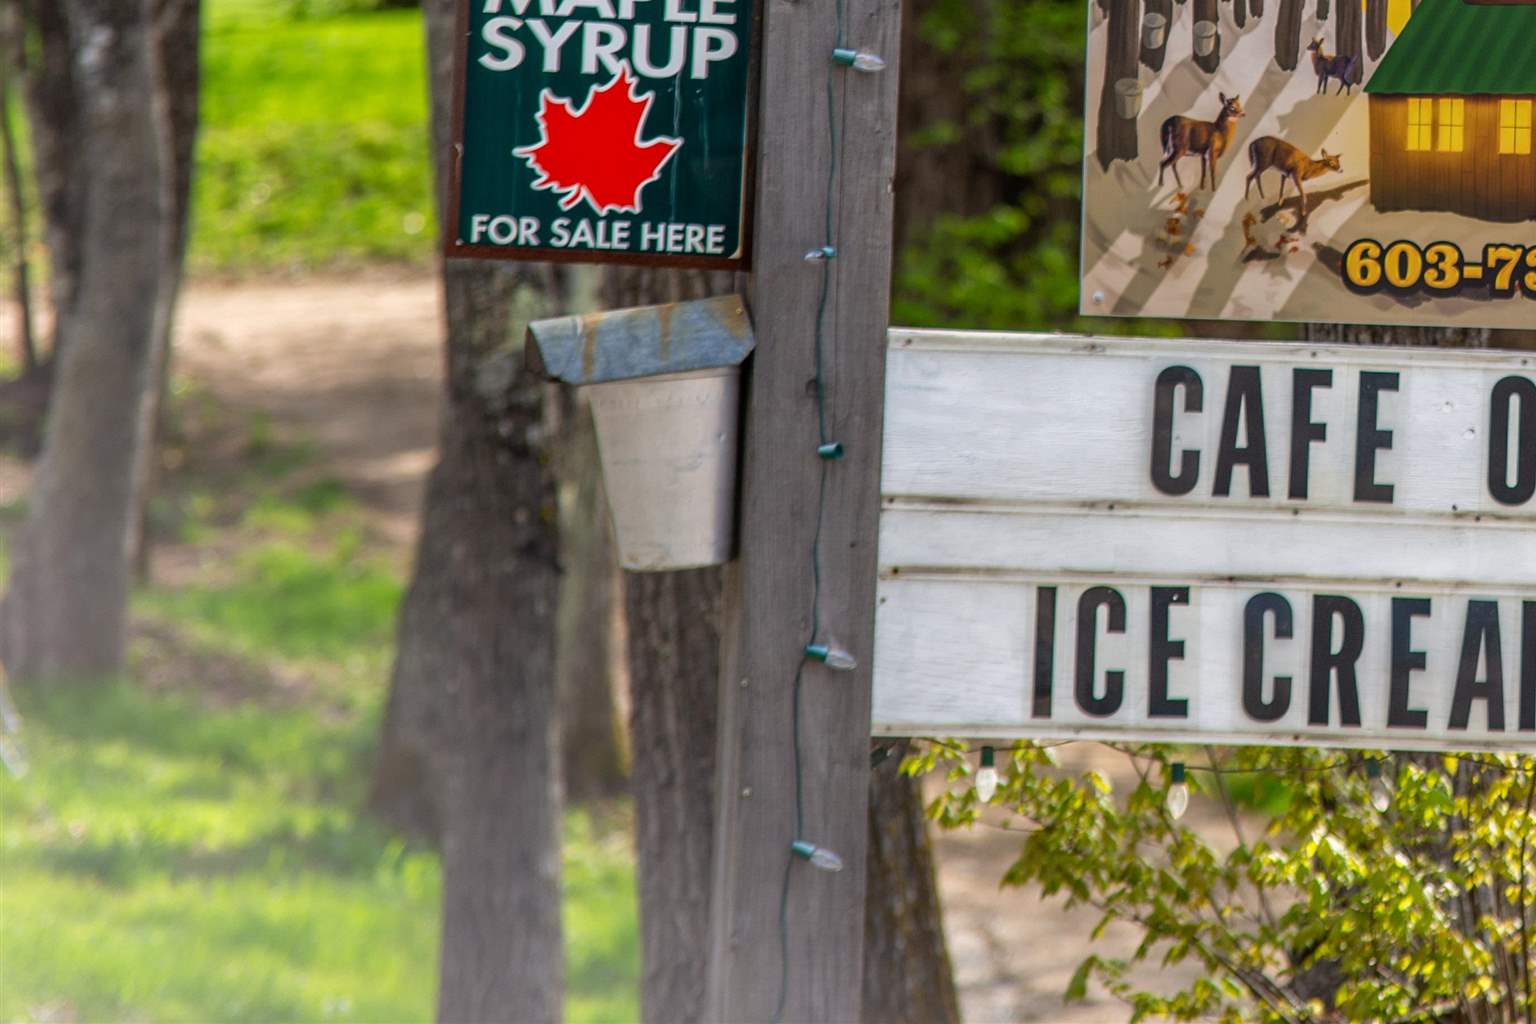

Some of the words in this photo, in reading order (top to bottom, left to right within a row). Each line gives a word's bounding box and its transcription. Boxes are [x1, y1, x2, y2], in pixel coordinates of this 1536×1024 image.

[478, 18, 738, 79] SYRUP
[470, 214, 540, 246] FOR
[549, 217, 630, 250] SALE
[640, 223, 726, 254] HERE
[1150, 364, 1399, 504] CAFE
[1031, 585, 1191, 719] ICE
